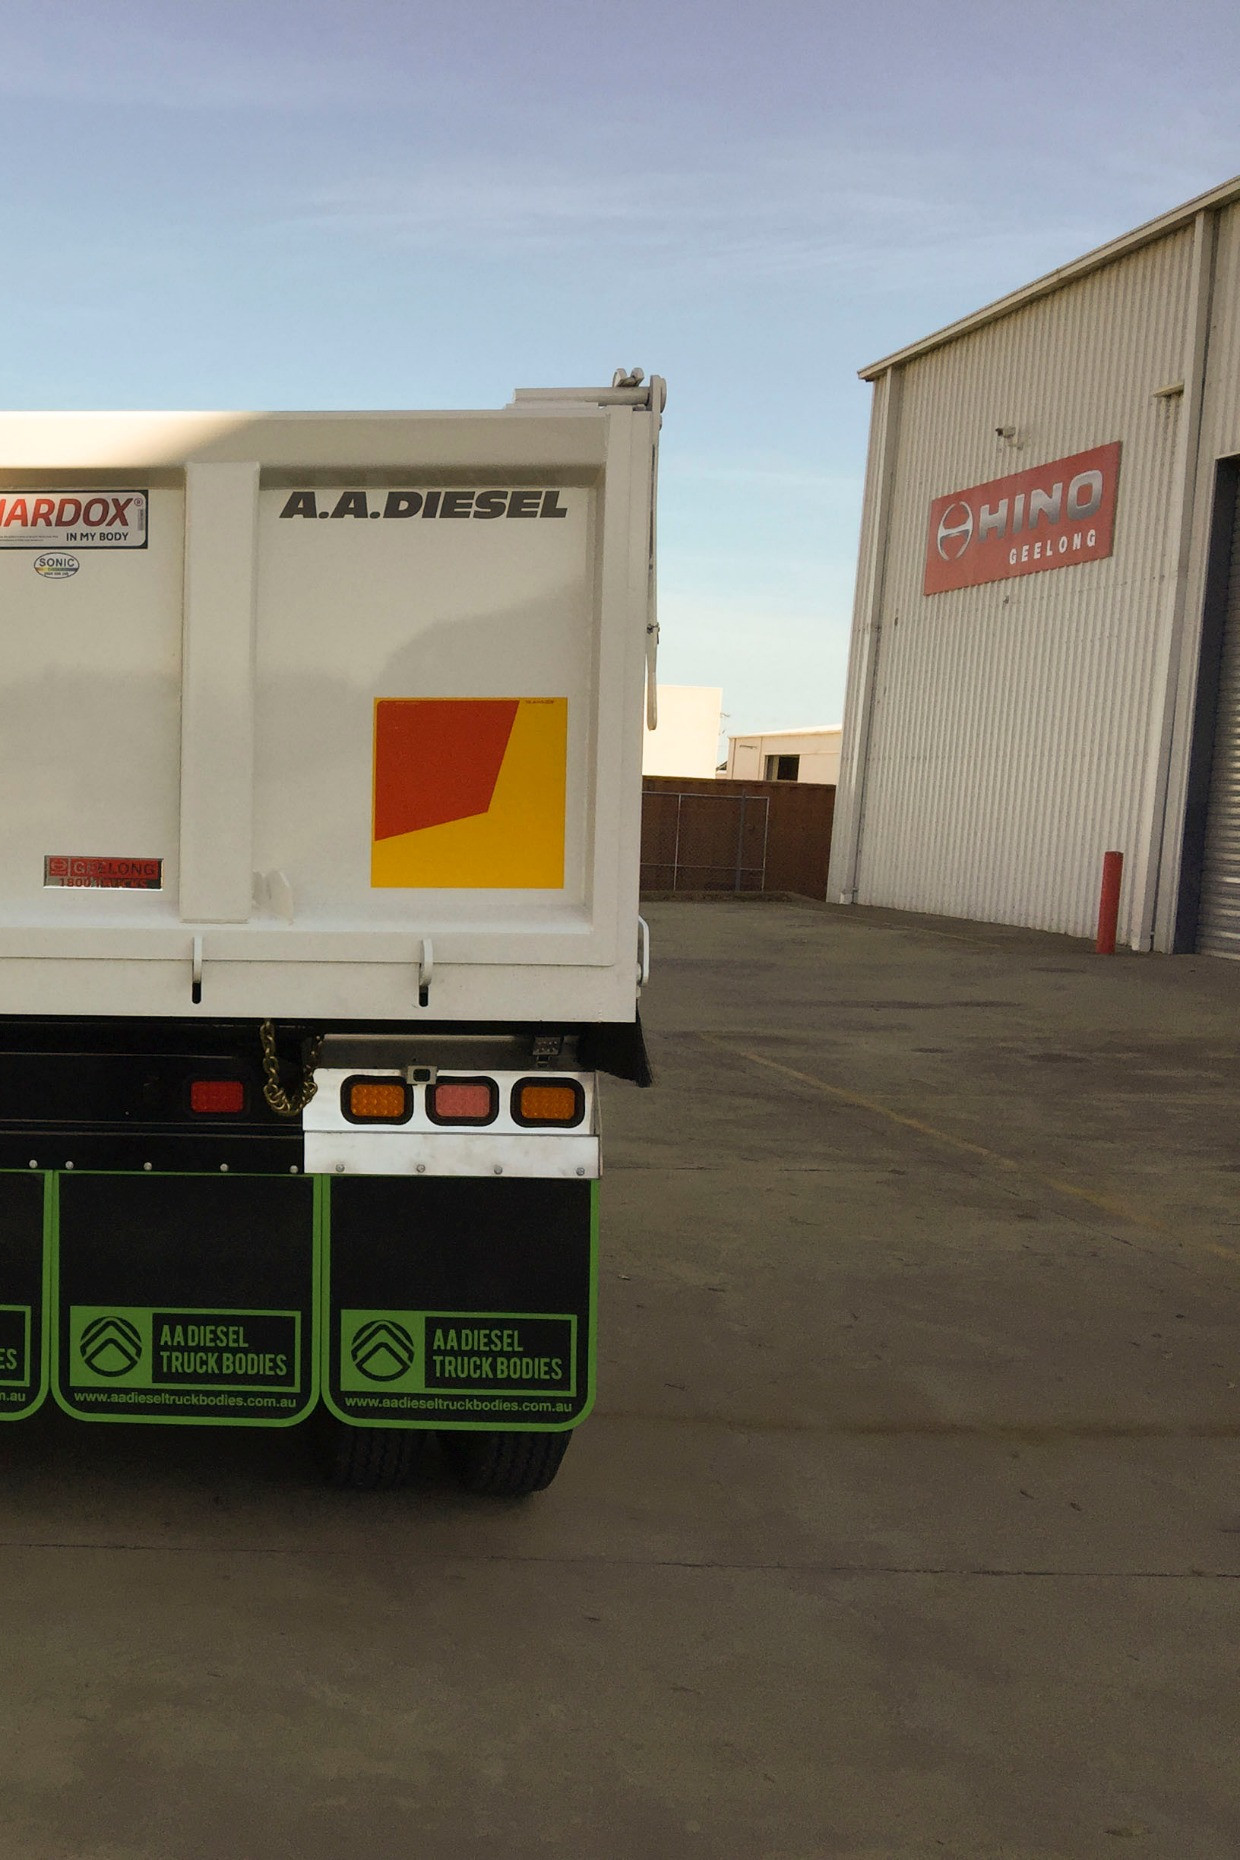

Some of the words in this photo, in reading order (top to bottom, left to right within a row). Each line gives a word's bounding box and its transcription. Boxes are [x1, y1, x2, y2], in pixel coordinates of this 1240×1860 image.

[279, 490, 568, 520] A.A.DIESEL
[979, 469, 1103, 543] HINO
[66, 532, 76, 542] IN
[80, 532, 96, 542] MY
[99, 532, 129, 542] BODY
[1009, 529, 1096, 565] GEELONG
[39, 557, 75, 567] SONIC
[188, 1326, 248, 1347] DIESEL
[461, 1330, 523, 1352] DIESEL
[160, 1352, 219, 1373] TRUCK
[223, 1353, 287, 1375] BODIES
[433, 1356, 493, 1378] TRUCK
[496, 1357, 563, 1380] BODIES
[74, 1392, 296, 1407] www.aadieseltruckbodies.com.au
[345, 1397, 572, 1412] www.aadieseltruckbodies.com.au
